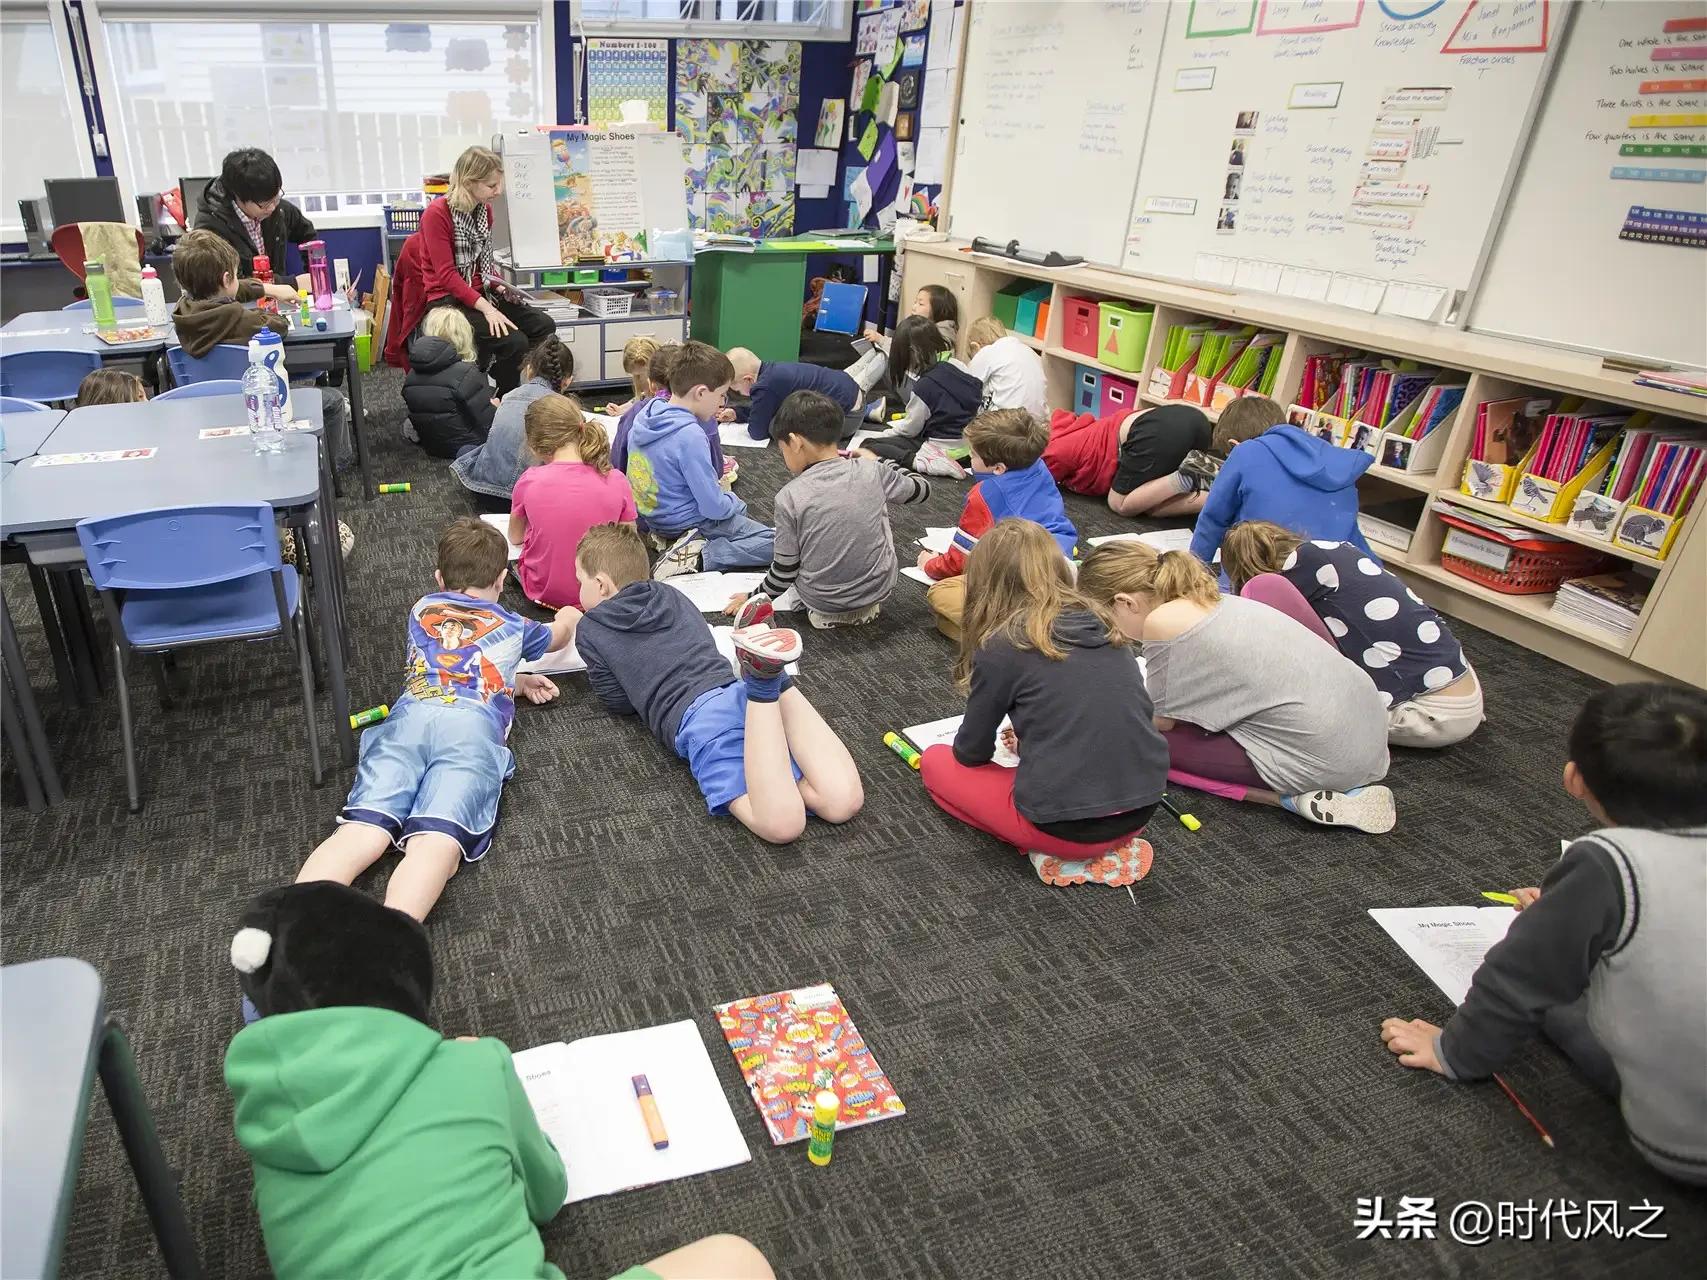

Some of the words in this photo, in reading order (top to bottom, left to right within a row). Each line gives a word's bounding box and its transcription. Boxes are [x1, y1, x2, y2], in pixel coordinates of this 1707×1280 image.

[1652, 65, 1659, 73] is
[566, 133, 579, 142] My
[581, 133, 606, 142] Magic
[609, 132, 635, 141] Shoes
[526, 1070, 551, 1080] Shoes
